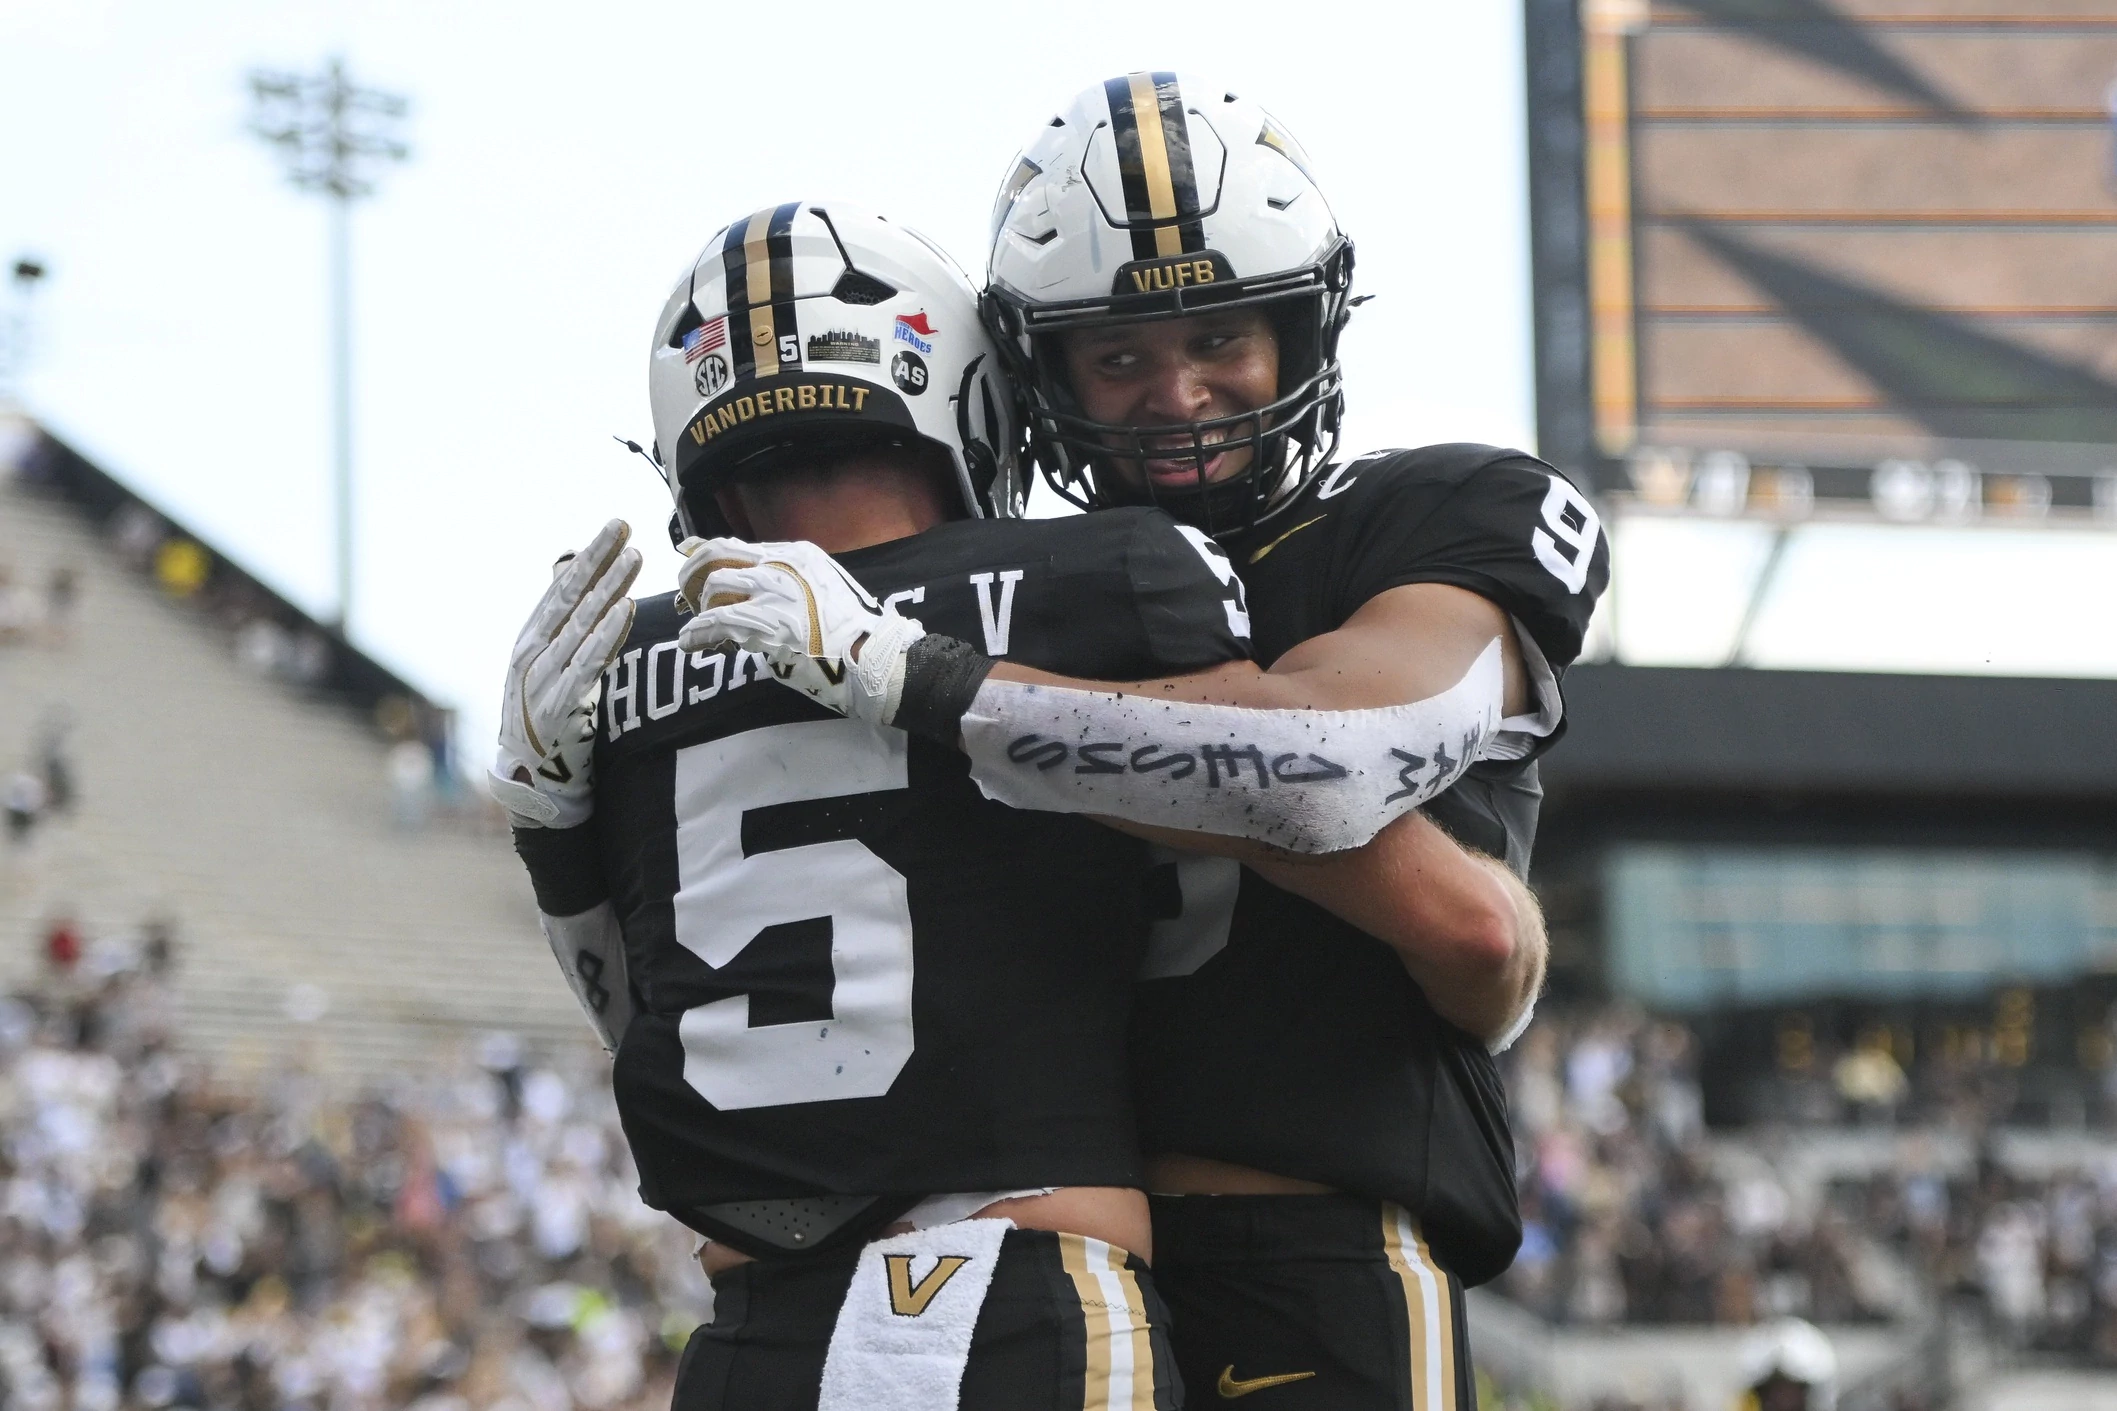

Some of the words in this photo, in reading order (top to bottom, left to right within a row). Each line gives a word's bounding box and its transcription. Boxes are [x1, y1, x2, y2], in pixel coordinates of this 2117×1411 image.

[1131, 259, 1215, 292] VUFB
[779, 334, 798, 362] 5
[894, 325, 932, 354] HEROES
[697, 355, 728, 396] SEC
[895, 360, 926, 387] AS
[689, 384, 870, 447] VANDERBILT
[1531, 474, 1601, 595] 9
[970, 569, 1024, 656] V
[1007, 733, 1348, 790] JESUS
[673, 717, 915, 1112] 5
[883, 1254, 973, 1317] V
